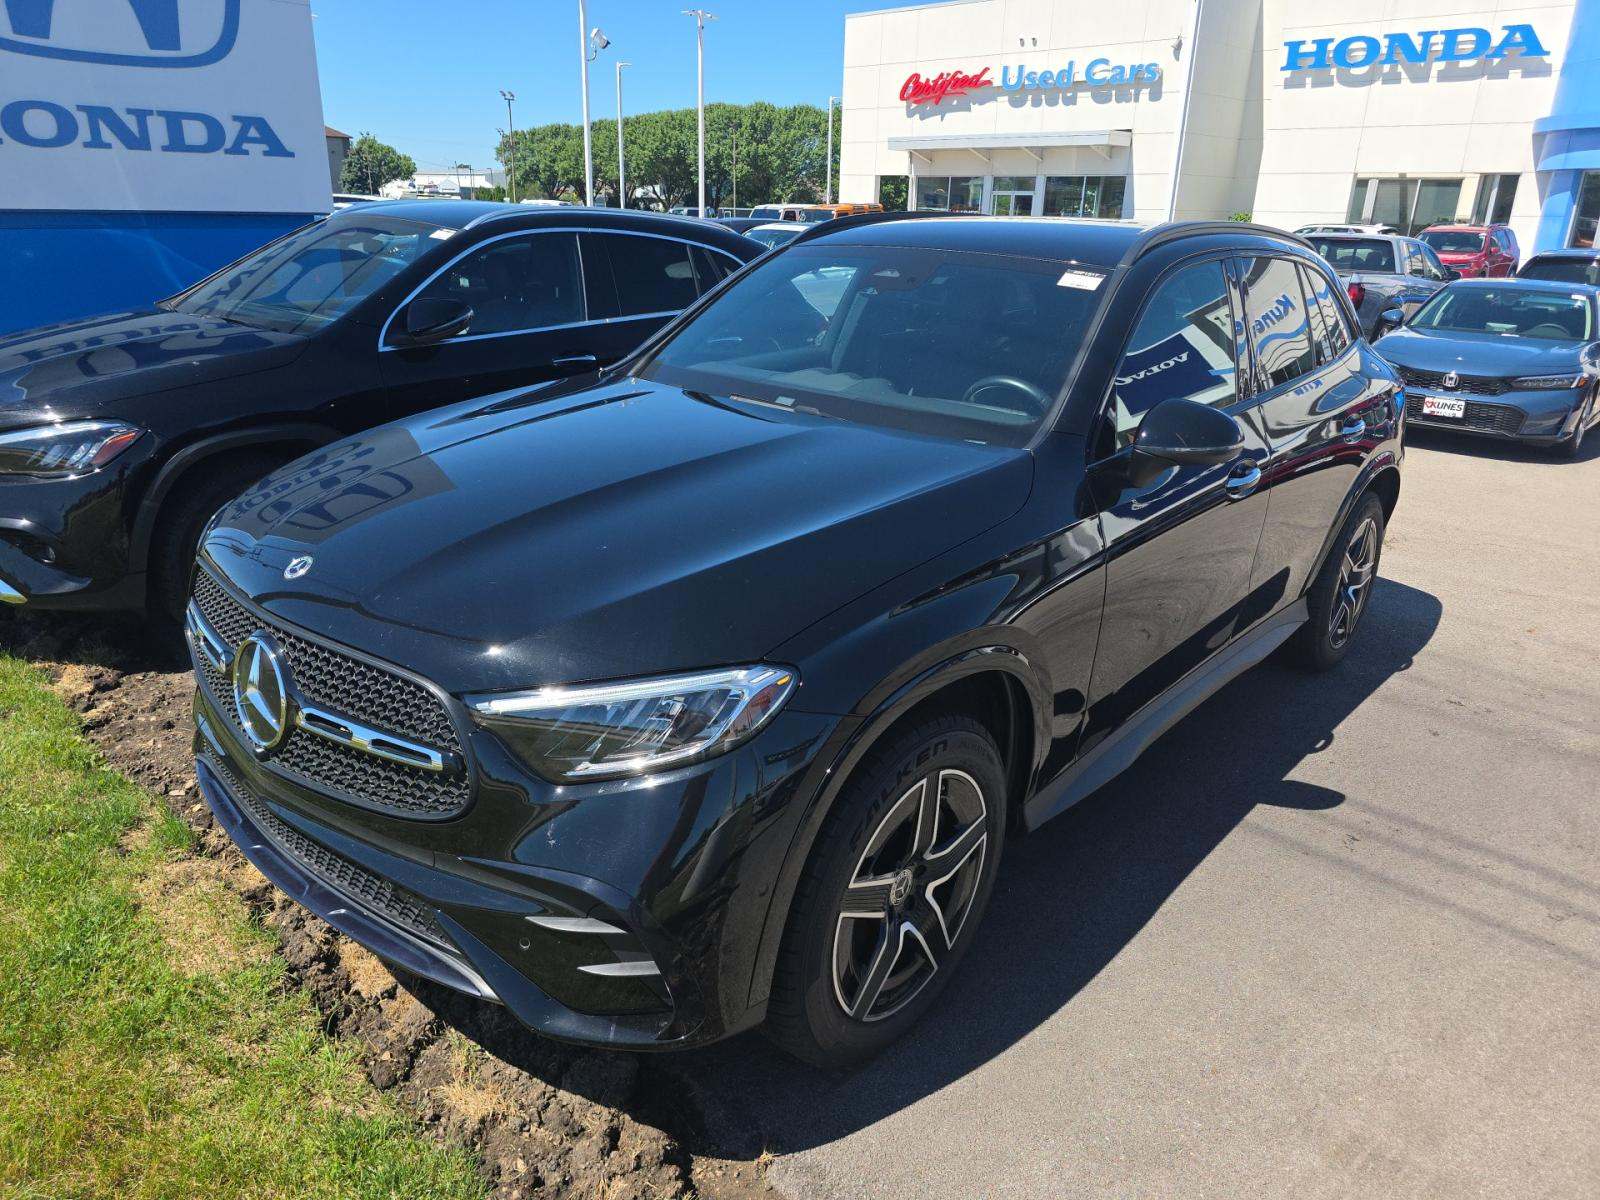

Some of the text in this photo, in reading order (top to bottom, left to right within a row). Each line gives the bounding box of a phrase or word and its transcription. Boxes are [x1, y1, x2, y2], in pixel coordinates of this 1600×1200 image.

[1280, 24, 1551, 71] HONDA
[900, 58, 1160, 105] Certified Used Cars
[0, 100, 296, 158] ONDA
[1432, 401, 1463, 412] KUNES
